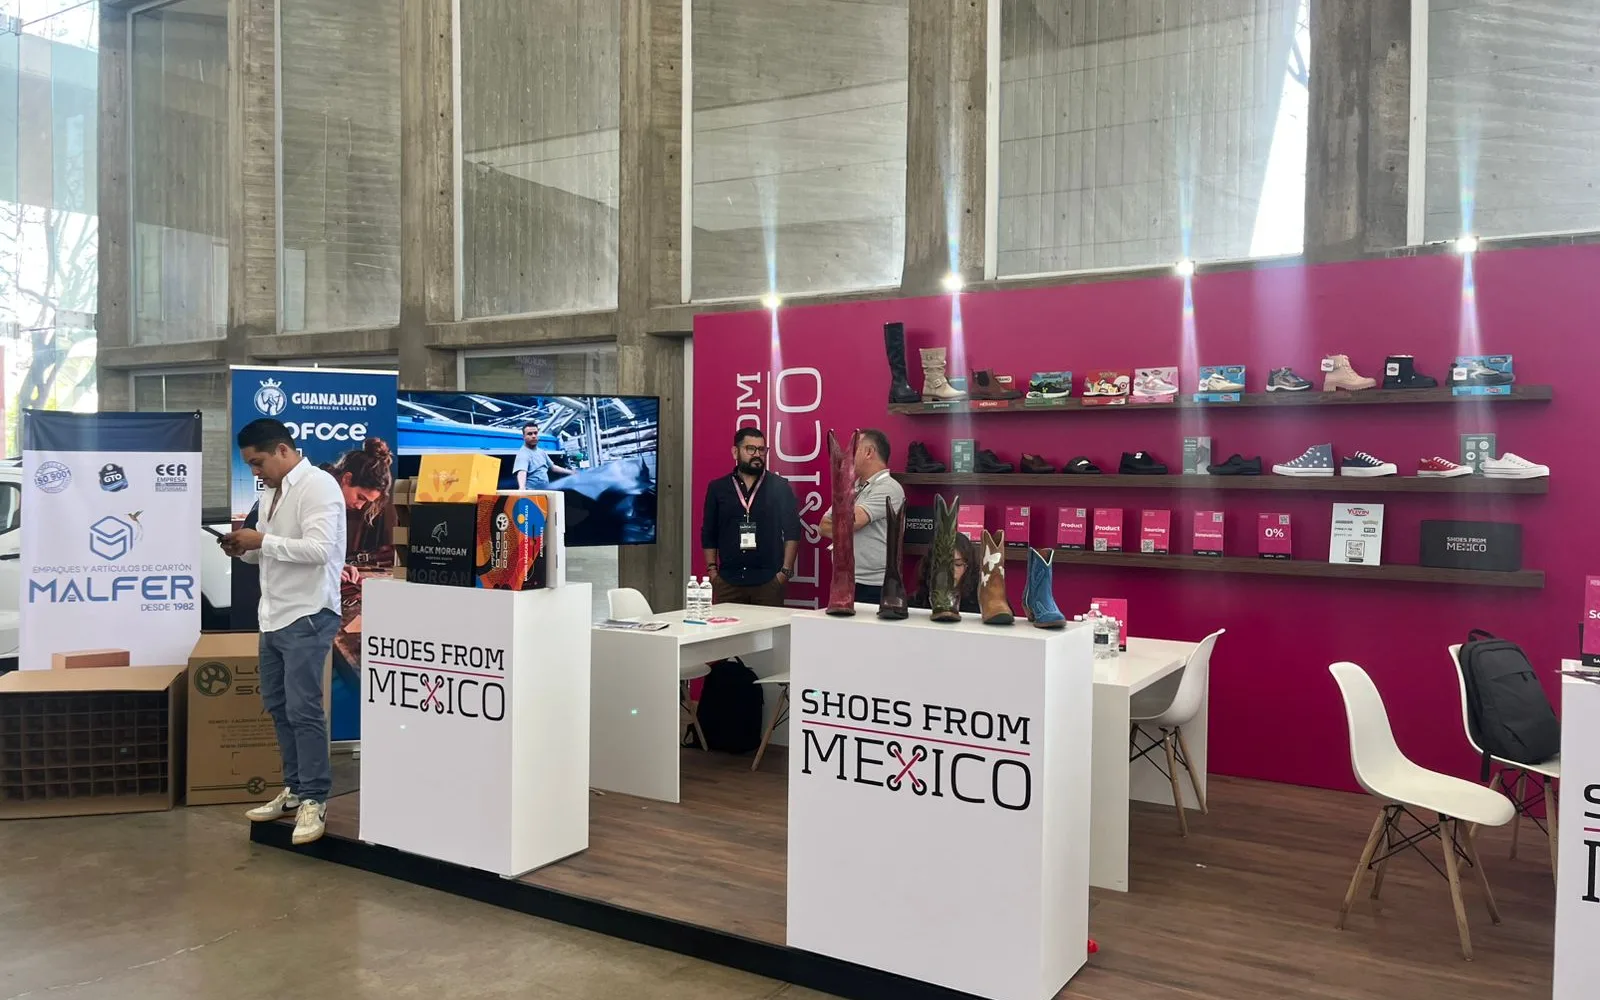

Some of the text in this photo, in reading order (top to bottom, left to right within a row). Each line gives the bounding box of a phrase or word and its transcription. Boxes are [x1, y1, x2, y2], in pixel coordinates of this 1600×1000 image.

[292, 392, 377, 407] GUANAJUATO
[155, 463, 187, 476] EER
[33, 469, 72, 485] ISO 9001
[103, 473, 123, 483] GTO
[1095, 524, 1121, 532] Product
[1265, 528, 1284, 538] 0%
[411, 545, 467, 556] BLACK MORGAN
[1446, 543, 1487, 552] MEXICO
[32, 565, 81, 574] EMPAQUES
[90, 564, 140, 573] ARTÍCULOS
[141, 564, 153, 572] DE
[155, 563, 192, 571] CARTÓN
[29, 575, 194, 603] MALFER
[173, 603, 194, 611] 1982
[368, 636, 504, 671] SHOES FROM
[368, 668, 505, 721] MEXICO
[801, 688, 1031, 745] SHOES FROM
[801, 728, 1032, 811] MEXICO
